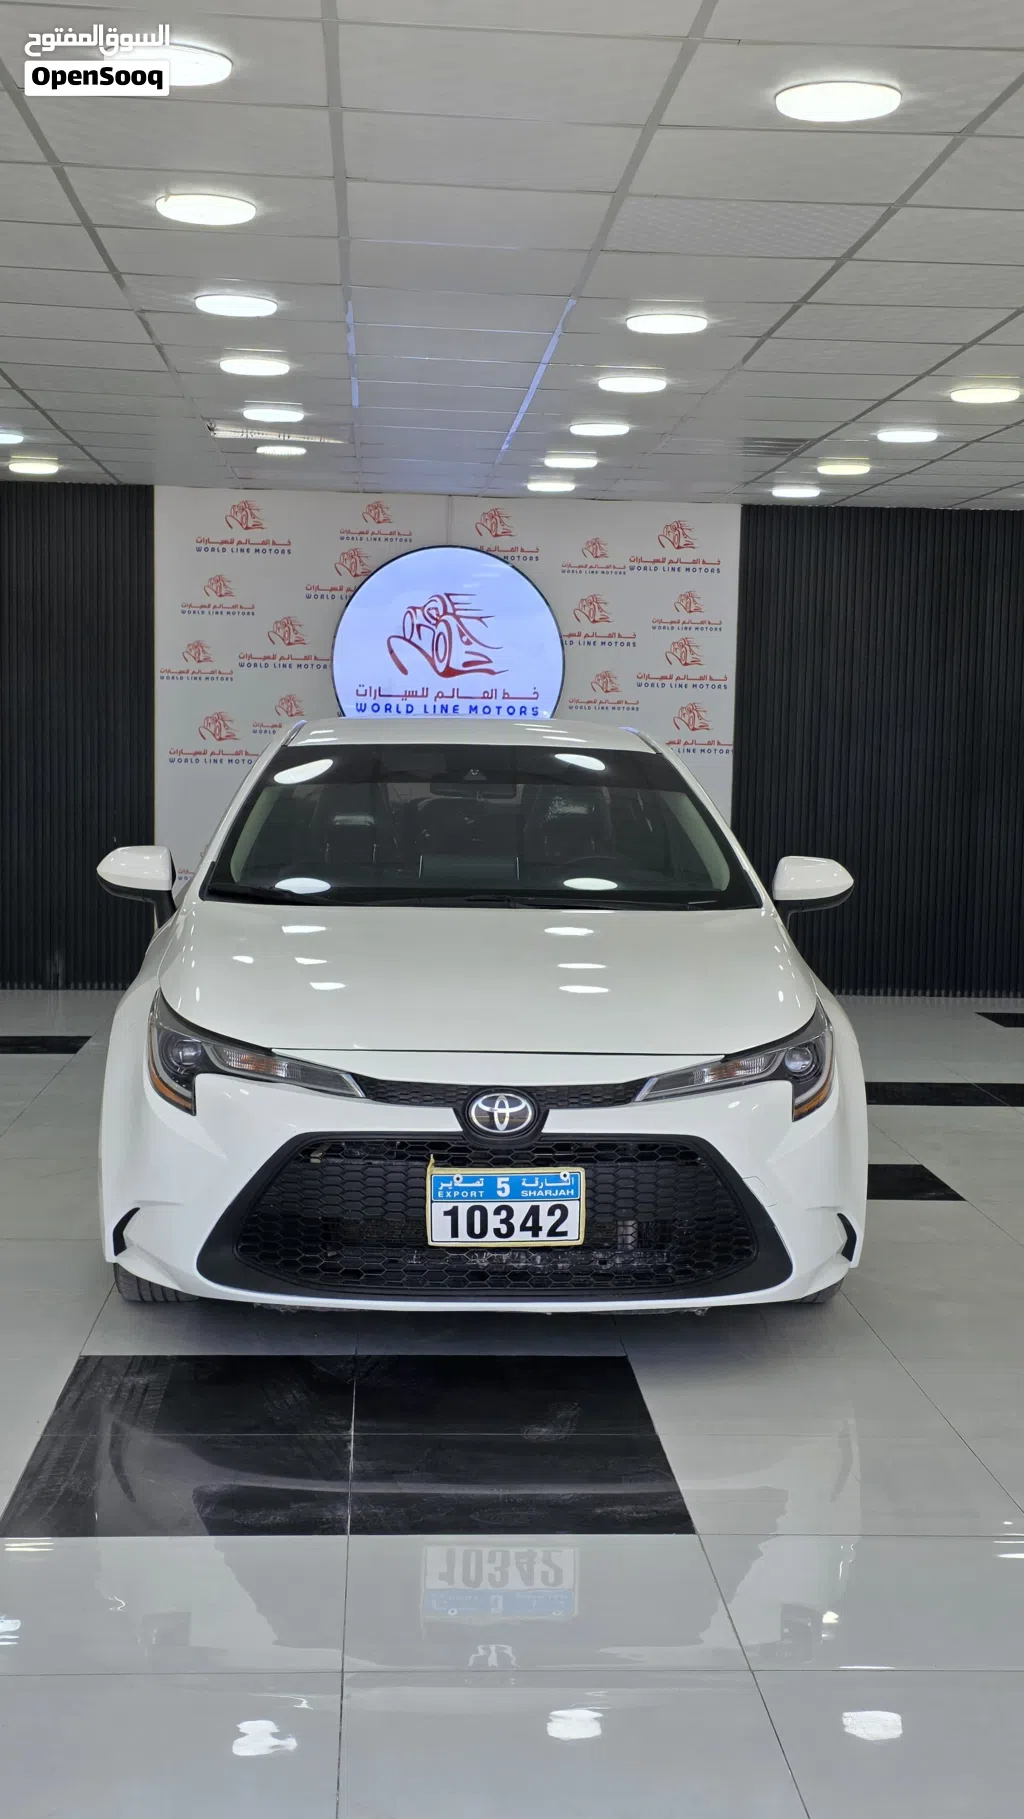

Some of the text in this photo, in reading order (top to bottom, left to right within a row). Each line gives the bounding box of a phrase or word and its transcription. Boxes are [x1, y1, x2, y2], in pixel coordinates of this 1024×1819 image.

[601, 640, 636, 648] MOTORS
[356, 684, 539, 701] خط العالم للسيارات
[356, 703, 539, 716] WORLD LINE MOTORS
[496, 1177, 510, 1197] 5
[521, 1189, 574, 1197] SHARJAH
[443, 1203, 569, 1240] 10342
